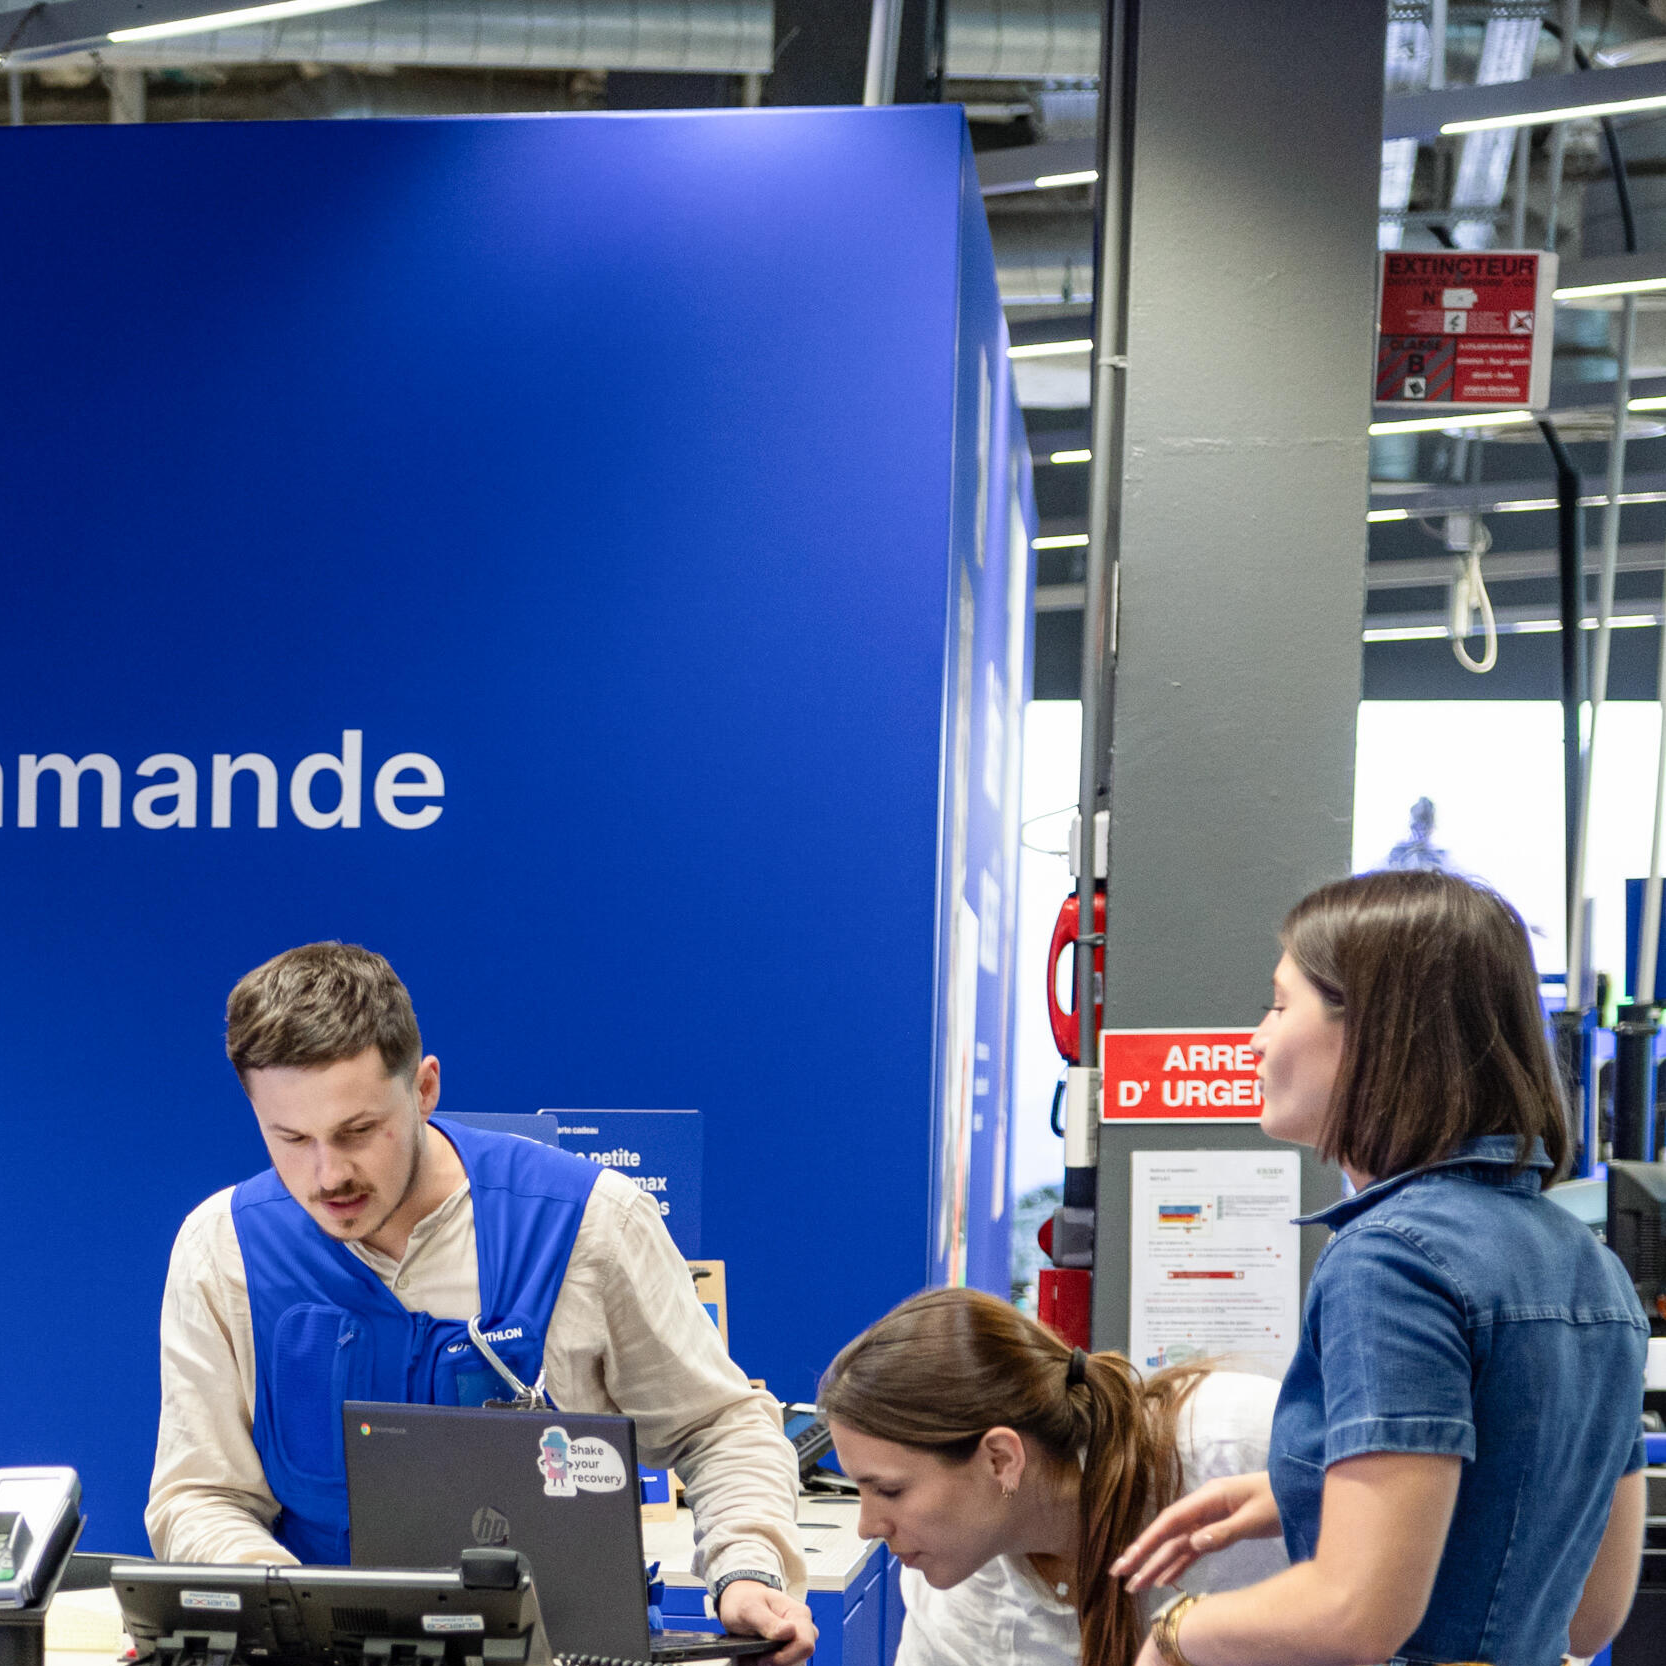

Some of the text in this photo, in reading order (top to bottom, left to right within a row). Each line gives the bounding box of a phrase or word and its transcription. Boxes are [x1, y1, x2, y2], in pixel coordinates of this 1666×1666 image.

[1388, 257, 1534, 276] EXTINCTEUR
[1408, 353, 1425, 373] B
[1162, 1044, 1255, 1071] ARRE
[1162, 1079, 1262, 1107] URGE
[557, 1127, 571, 1135] arte
[570, 1444, 604, 1456] Shake
[574, 1460, 600, 1471] your
[572, 1473, 623, 1486] recovery
